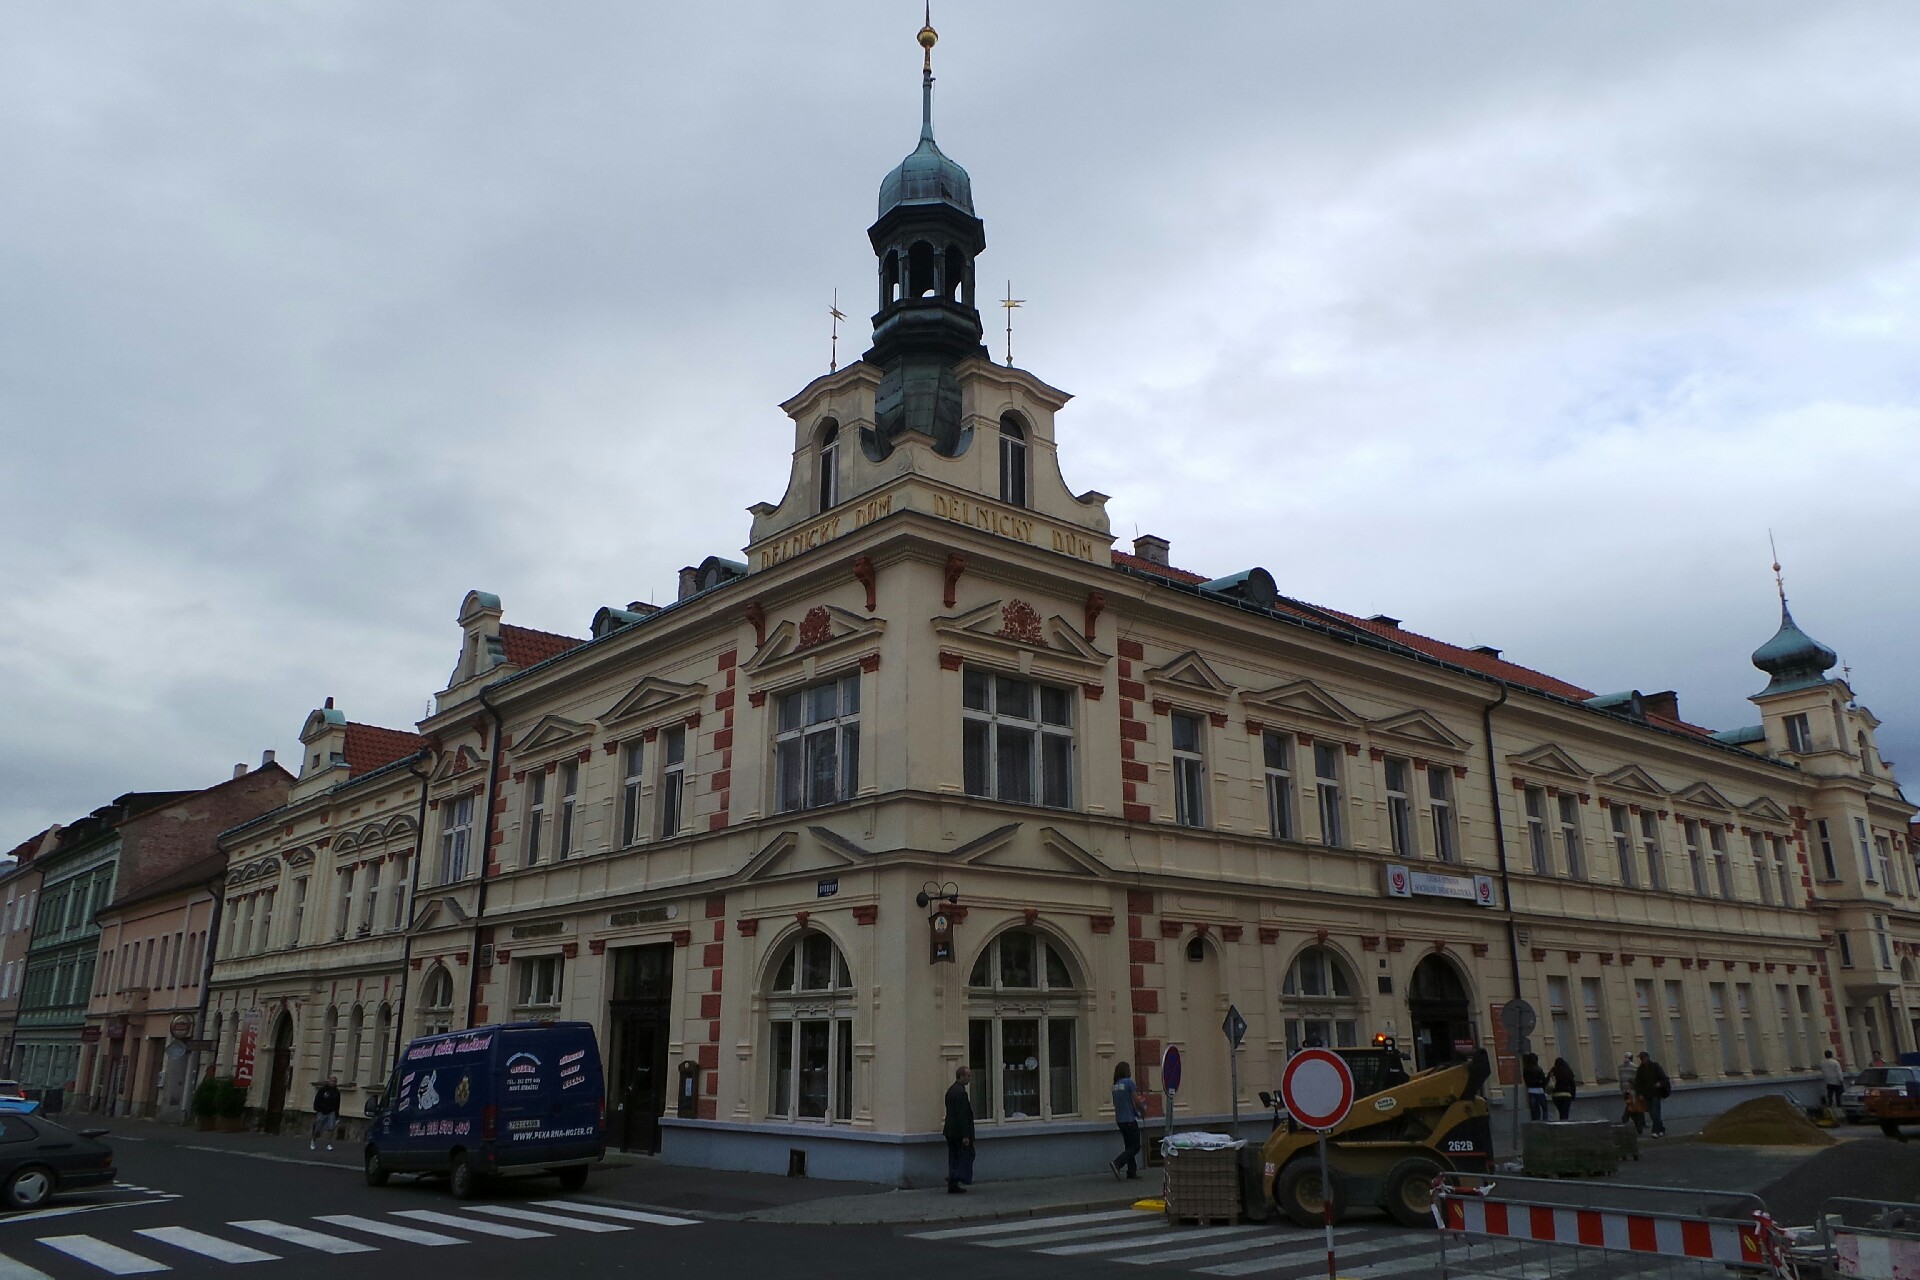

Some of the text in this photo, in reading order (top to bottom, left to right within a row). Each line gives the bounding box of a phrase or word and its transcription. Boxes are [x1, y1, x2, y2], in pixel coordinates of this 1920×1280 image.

[933, 493, 1034, 543] DĚLNICKÝ
[238, 1024, 258, 1079] Pizza
[1447, 1140, 1474, 1152] 262B
